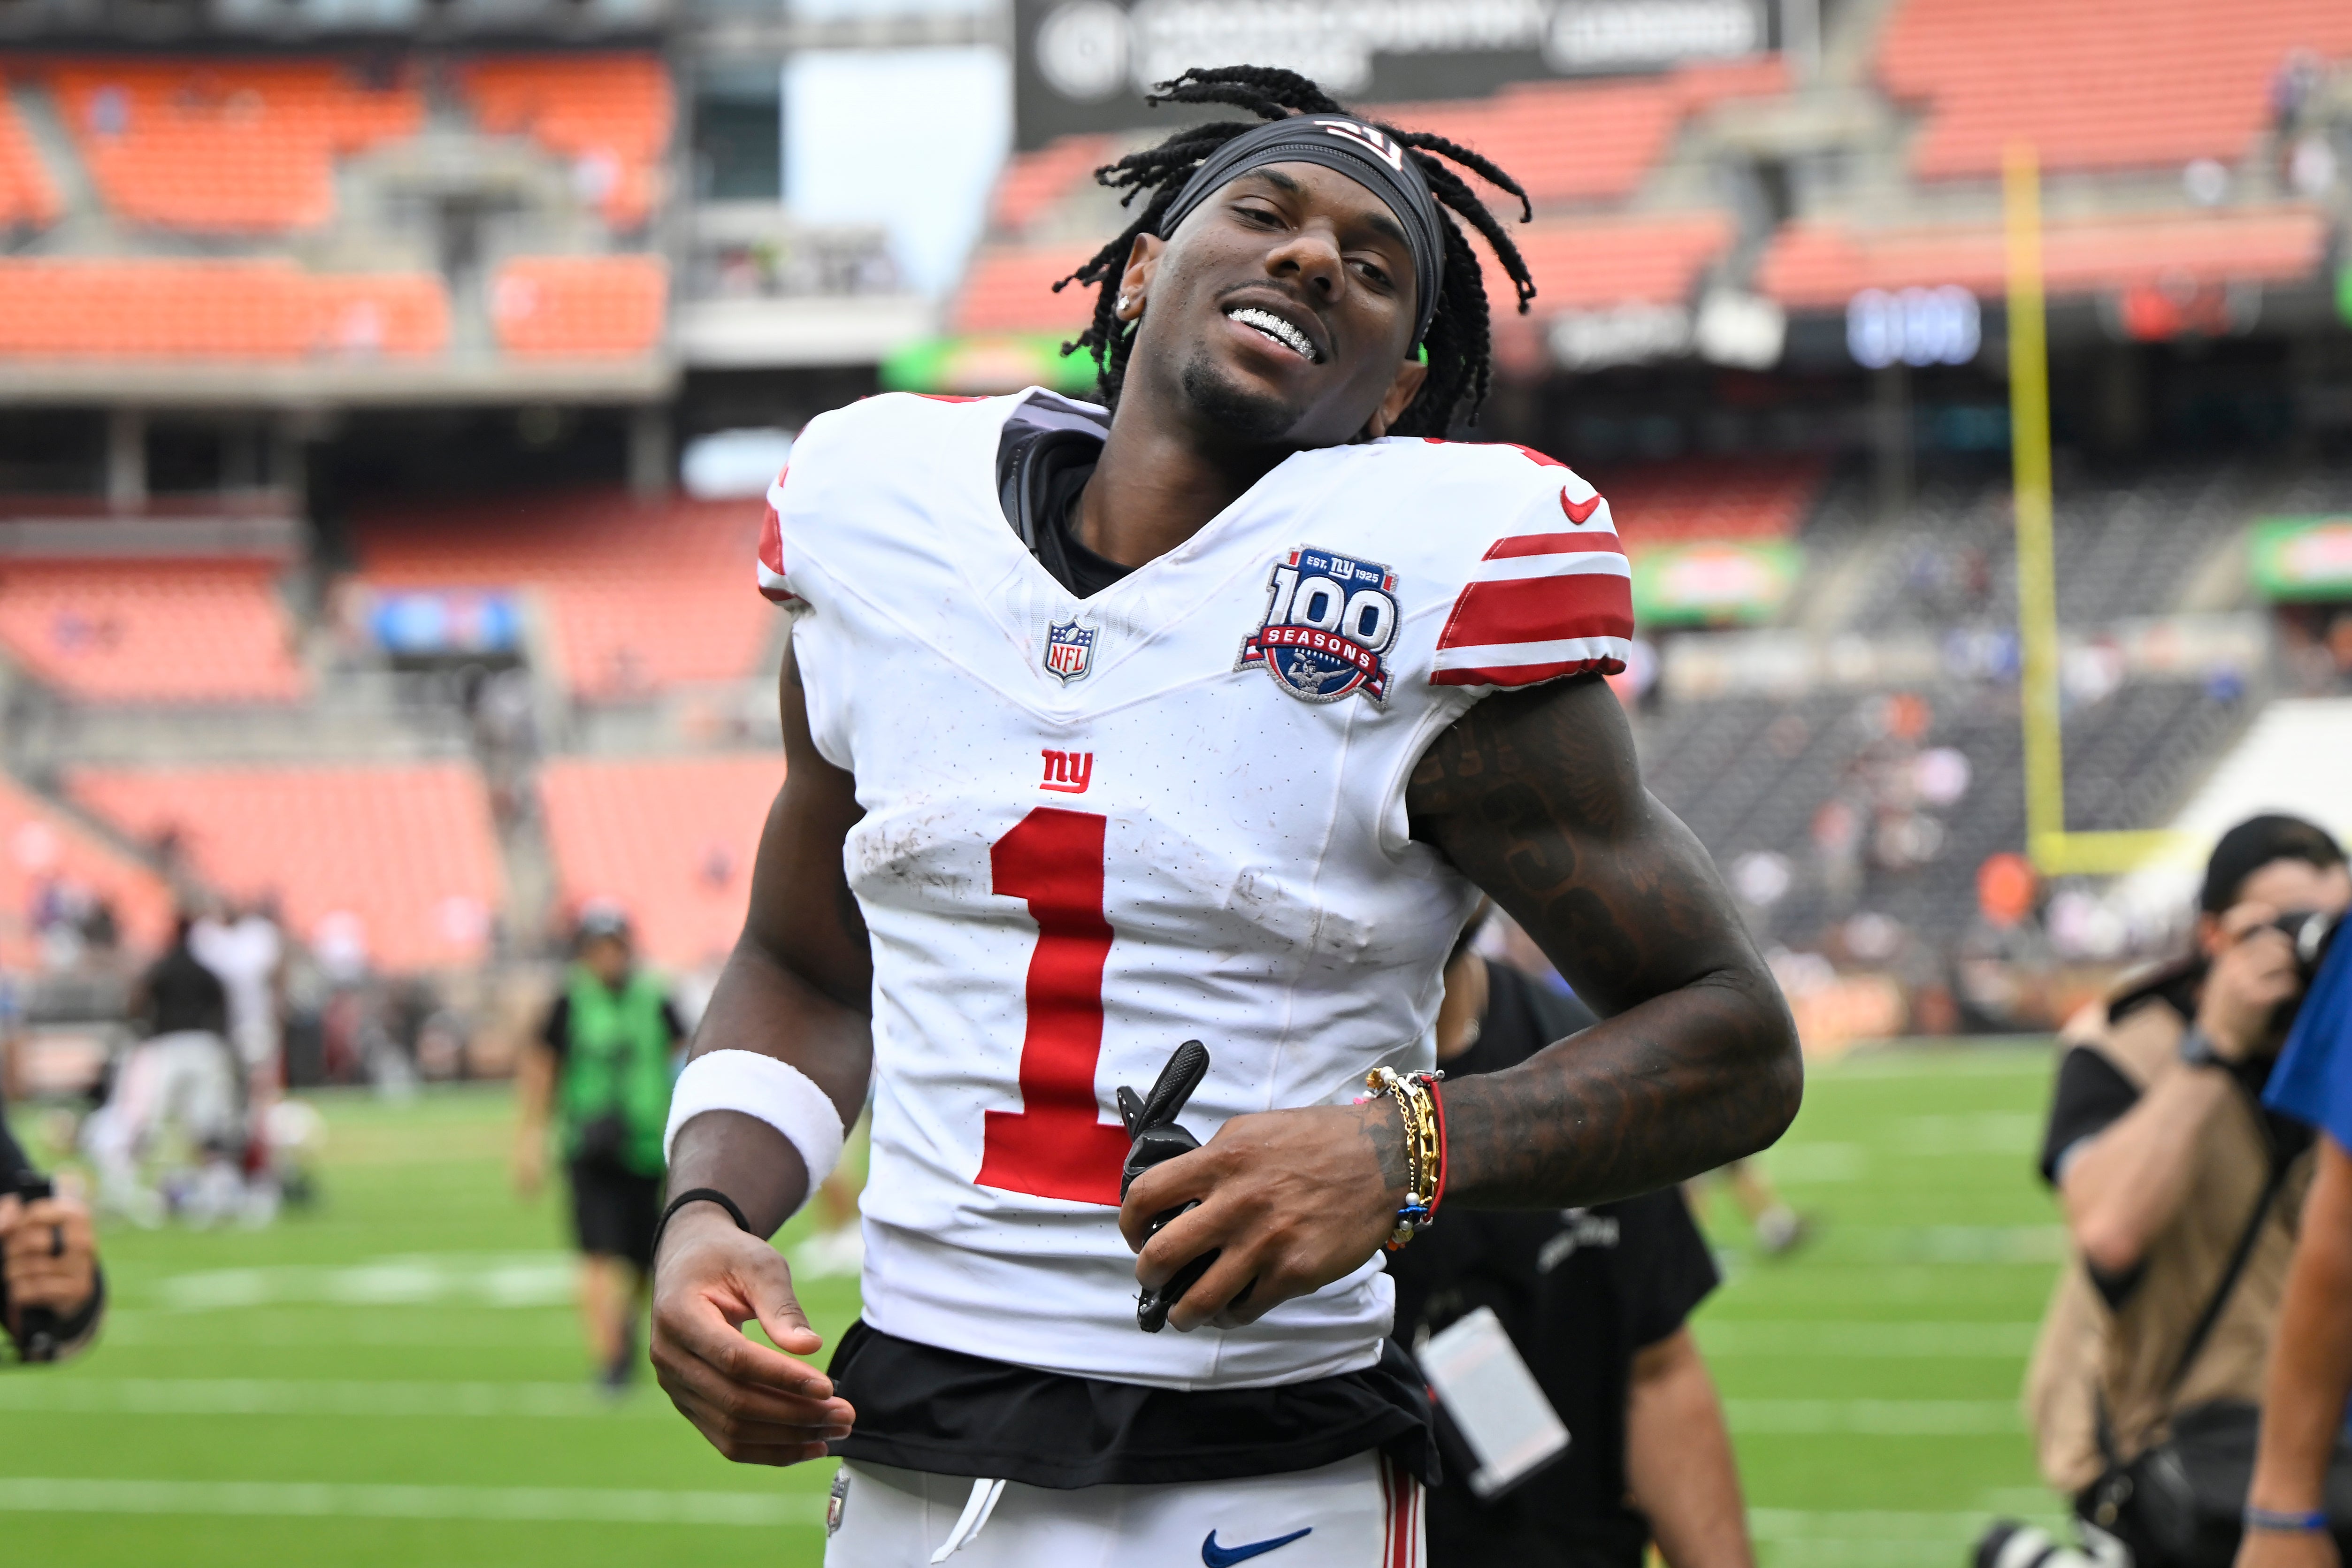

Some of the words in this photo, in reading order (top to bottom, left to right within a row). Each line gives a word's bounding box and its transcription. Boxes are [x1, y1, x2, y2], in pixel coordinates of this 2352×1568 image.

[1307, 556, 1327, 569] EST.
[1356, 569, 1379, 583] 1925
[1267, 566, 1395, 652] 100
[1049, 644, 1085, 673] NFL
[1268, 629, 1370, 667] SEASONS
[973, 806, 1133, 1207] 1
